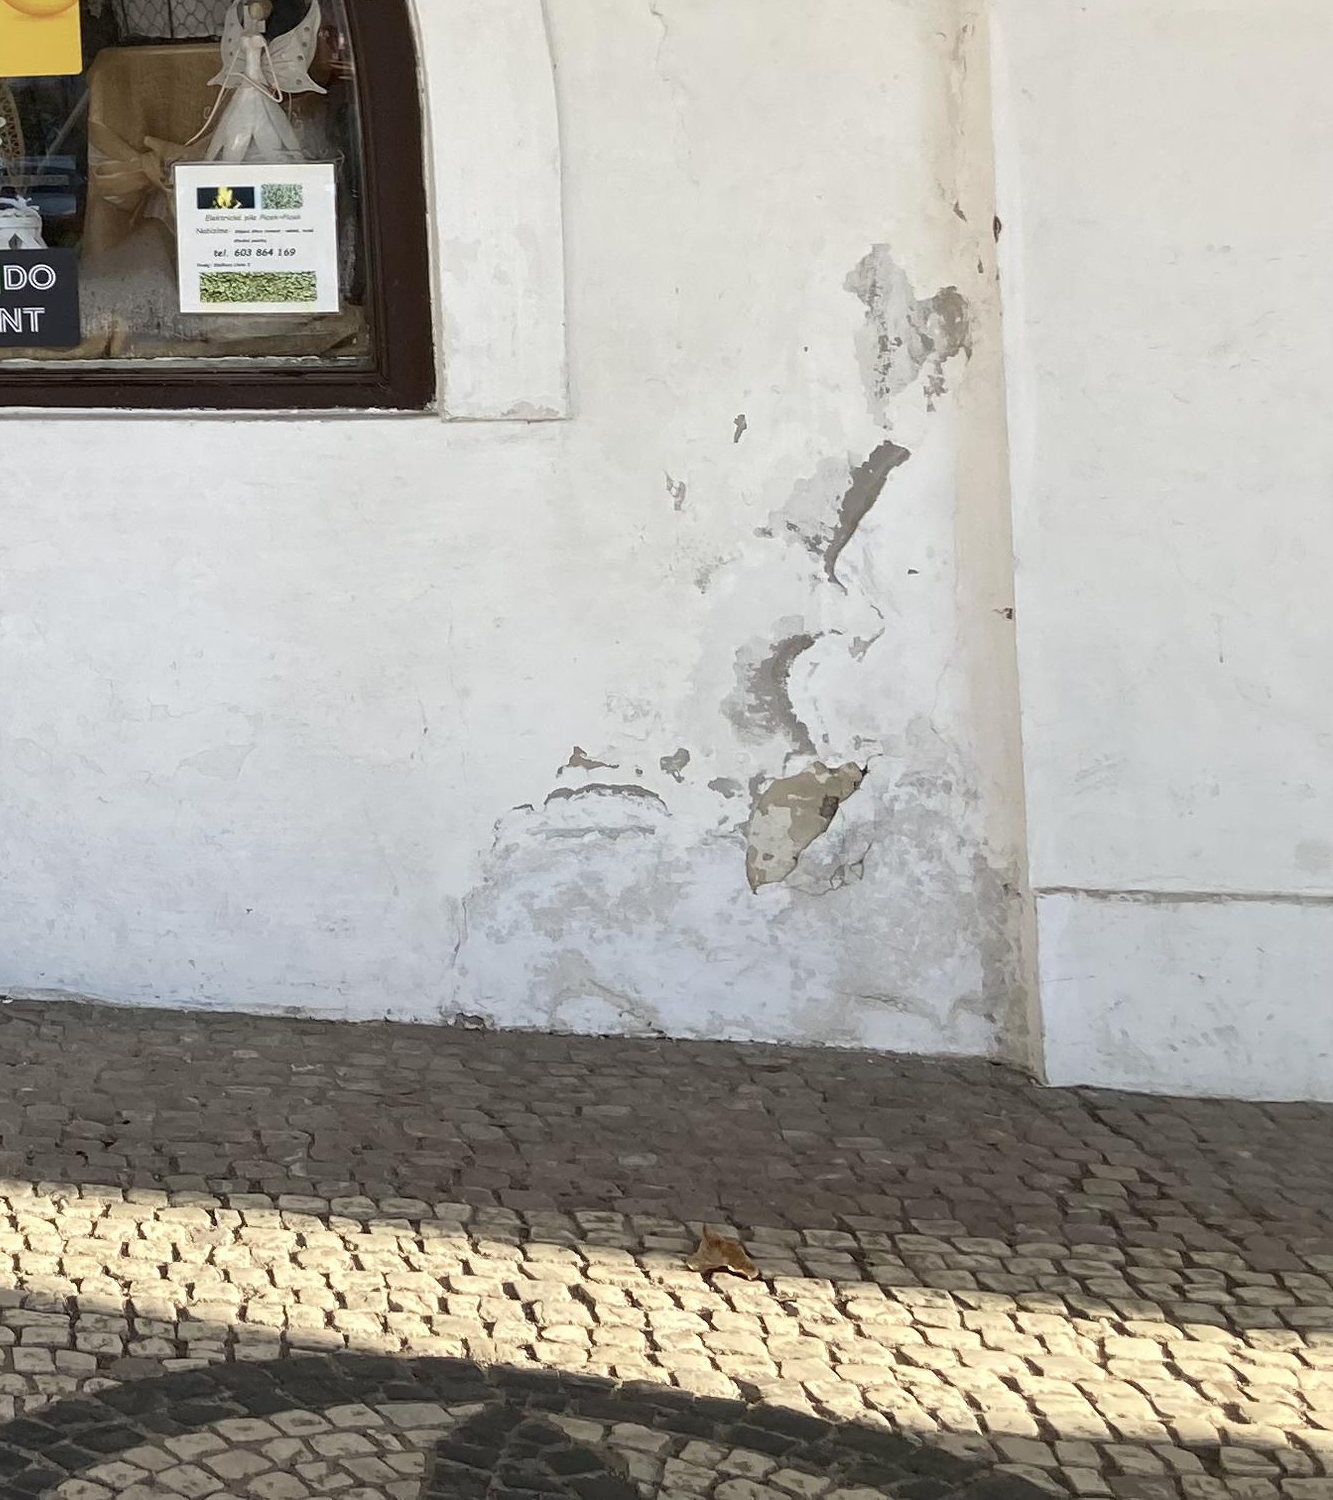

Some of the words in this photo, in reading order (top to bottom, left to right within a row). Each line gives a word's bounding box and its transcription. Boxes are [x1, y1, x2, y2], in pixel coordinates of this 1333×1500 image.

[234, 248, 252, 257] 603
[256, 248, 274, 257] 864
[278, 248, 296, 257] 169
